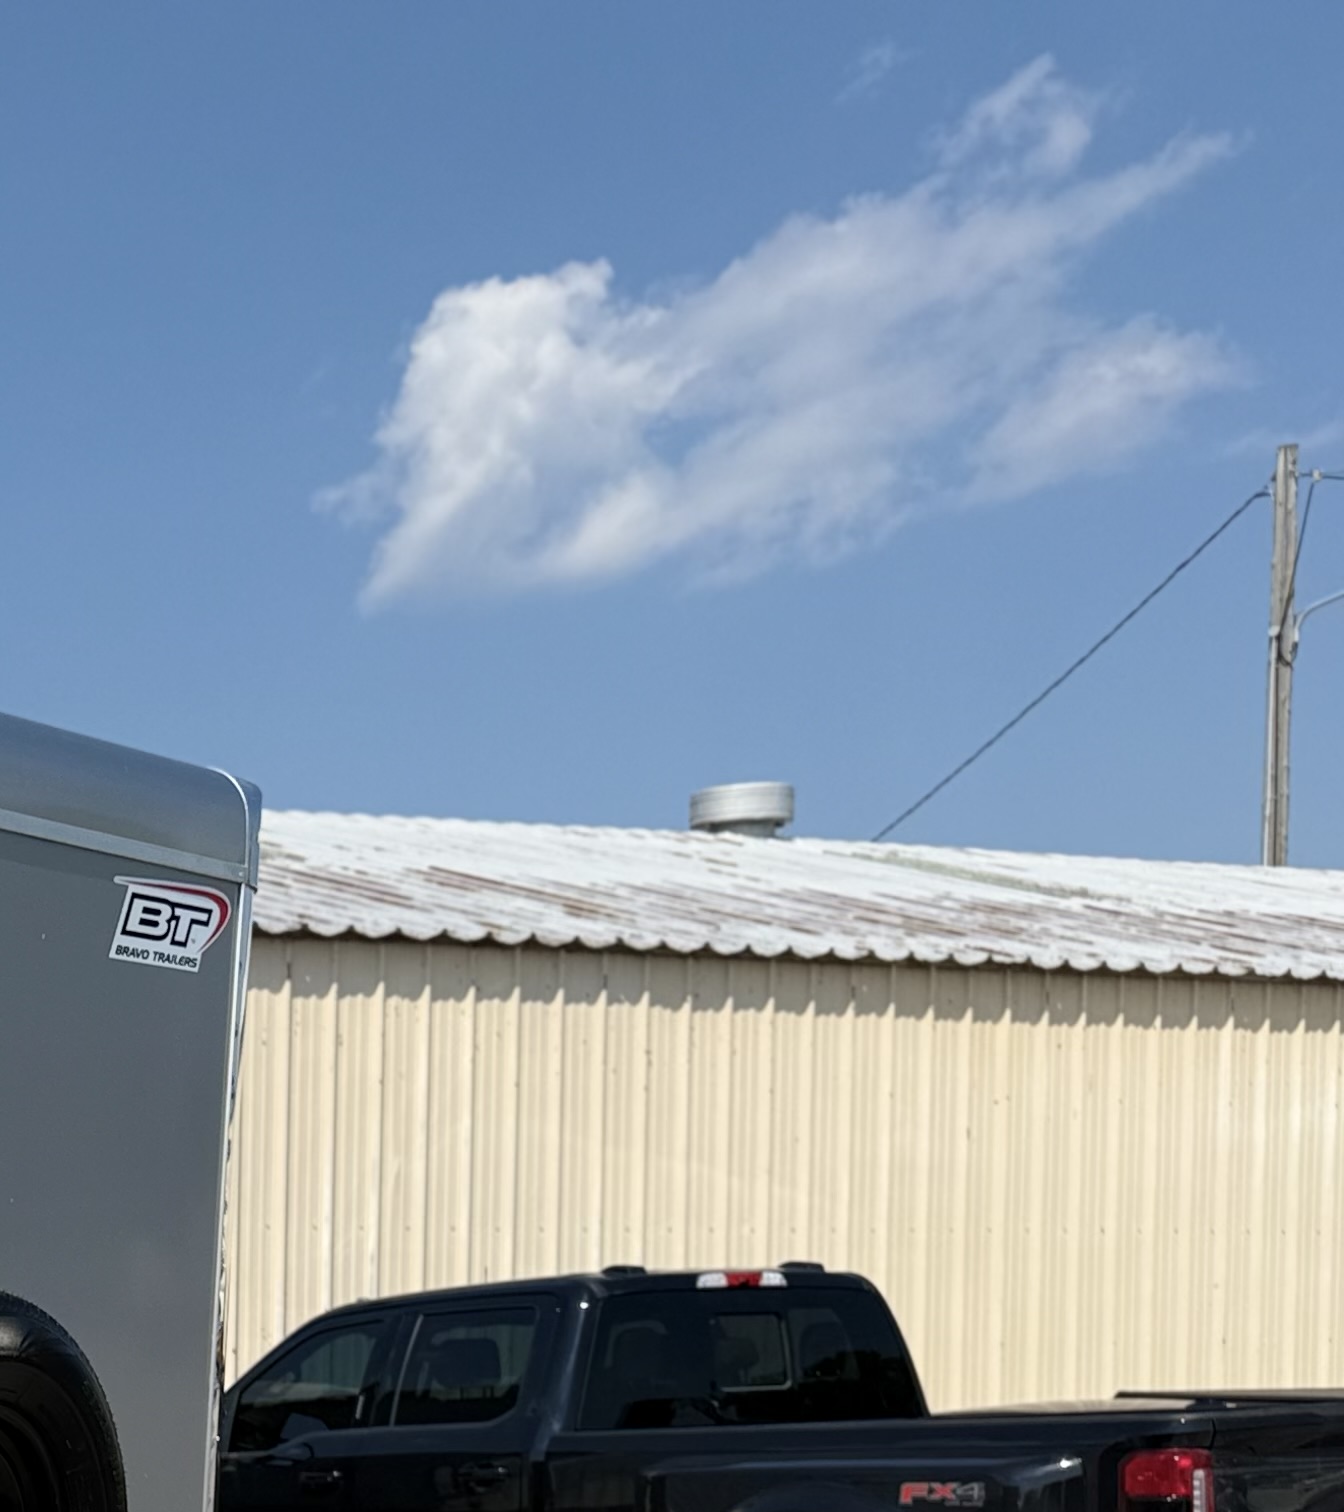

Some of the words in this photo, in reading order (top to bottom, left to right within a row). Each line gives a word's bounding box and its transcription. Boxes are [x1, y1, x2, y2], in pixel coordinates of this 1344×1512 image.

[120, 892, 213, 949] BT
[115, 944, 150, 960] BRAVO
[153, 951, 198, 969] TRAILERS
[899, 1481, 986, 1506] FX4
